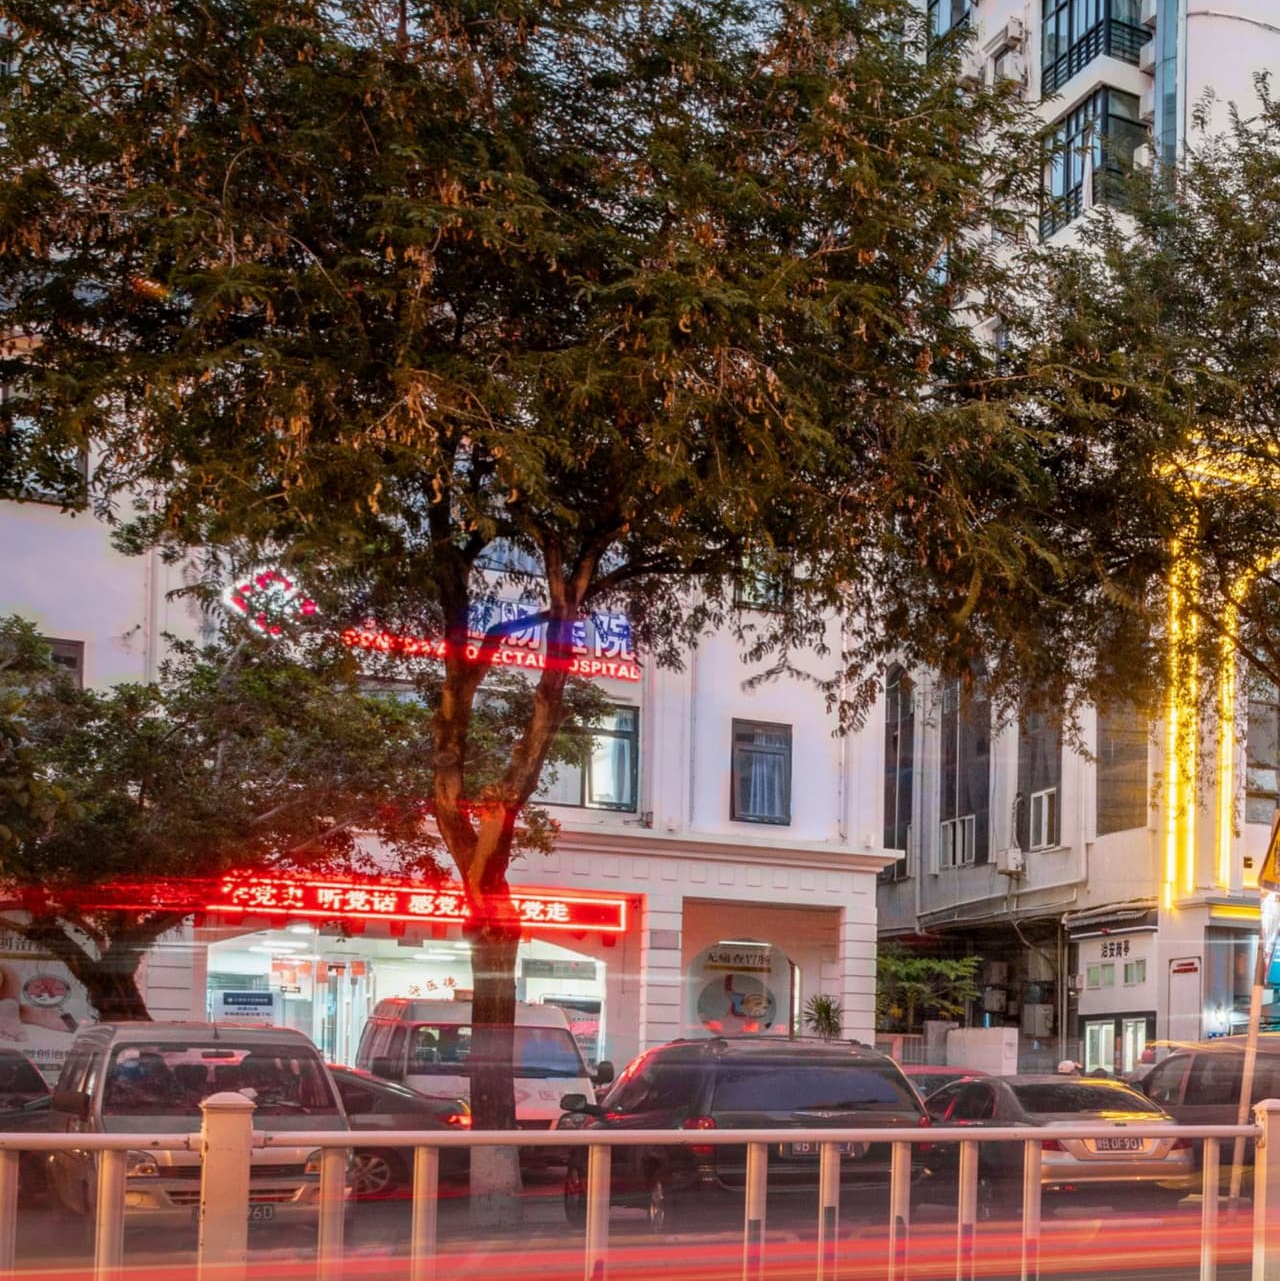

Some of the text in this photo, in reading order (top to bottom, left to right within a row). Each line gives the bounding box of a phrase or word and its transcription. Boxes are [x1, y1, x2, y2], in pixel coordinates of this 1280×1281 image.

[317, 888, 397, 913] 听党话
[511, 900, 570, 922] 党走
